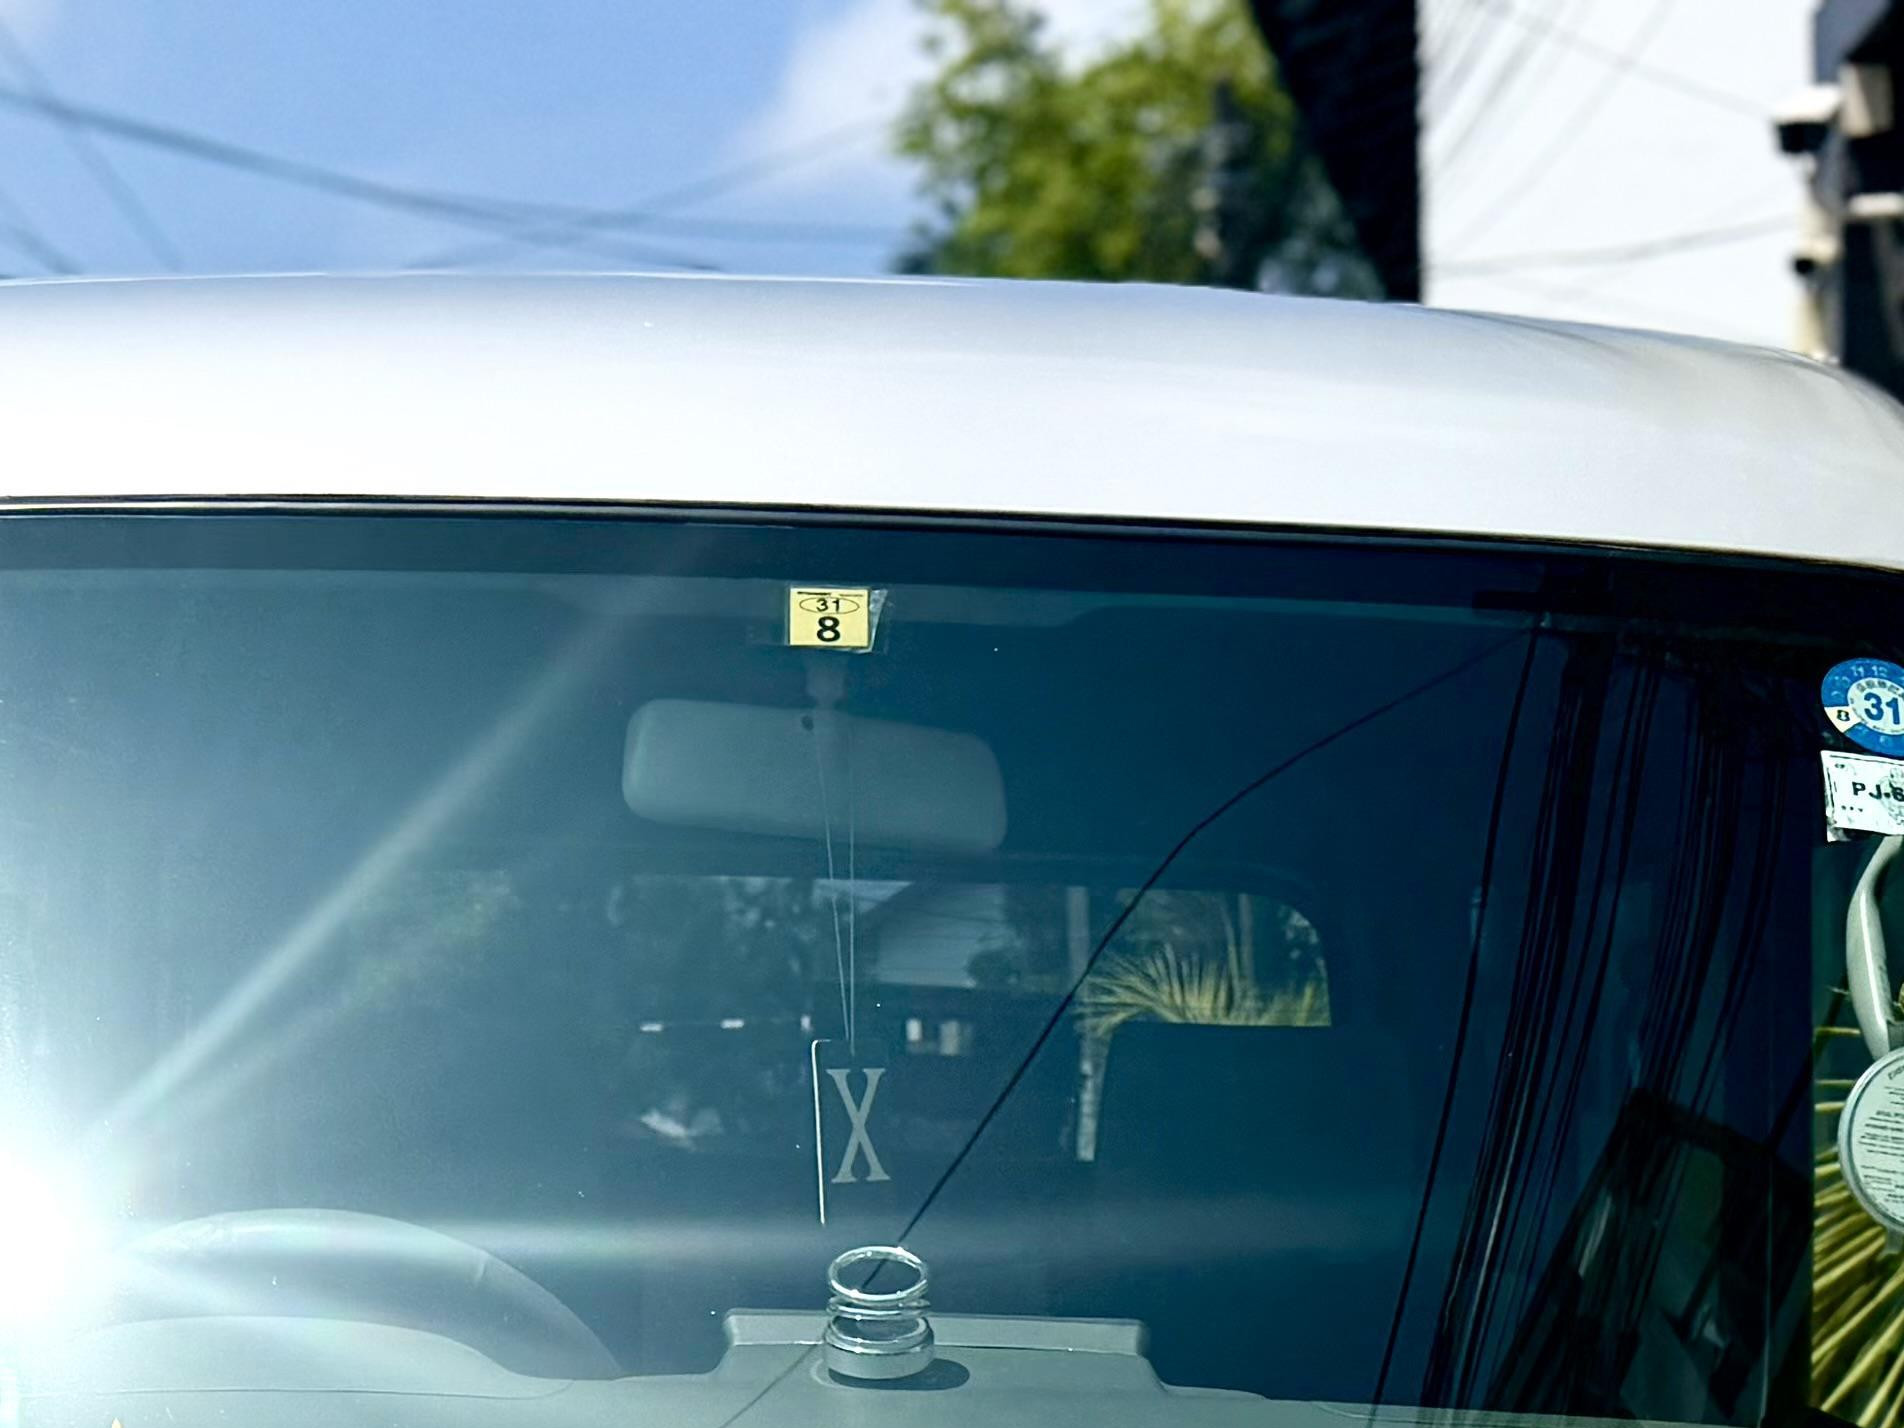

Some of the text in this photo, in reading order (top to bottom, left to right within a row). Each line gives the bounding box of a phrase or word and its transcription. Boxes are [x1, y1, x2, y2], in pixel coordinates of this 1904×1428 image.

[816, 597, 840, 612] 31
[816, 616, 841, 643] 8
[1863, 691, 1901, 726] 31
[826, 1068, 891, 1184] X
